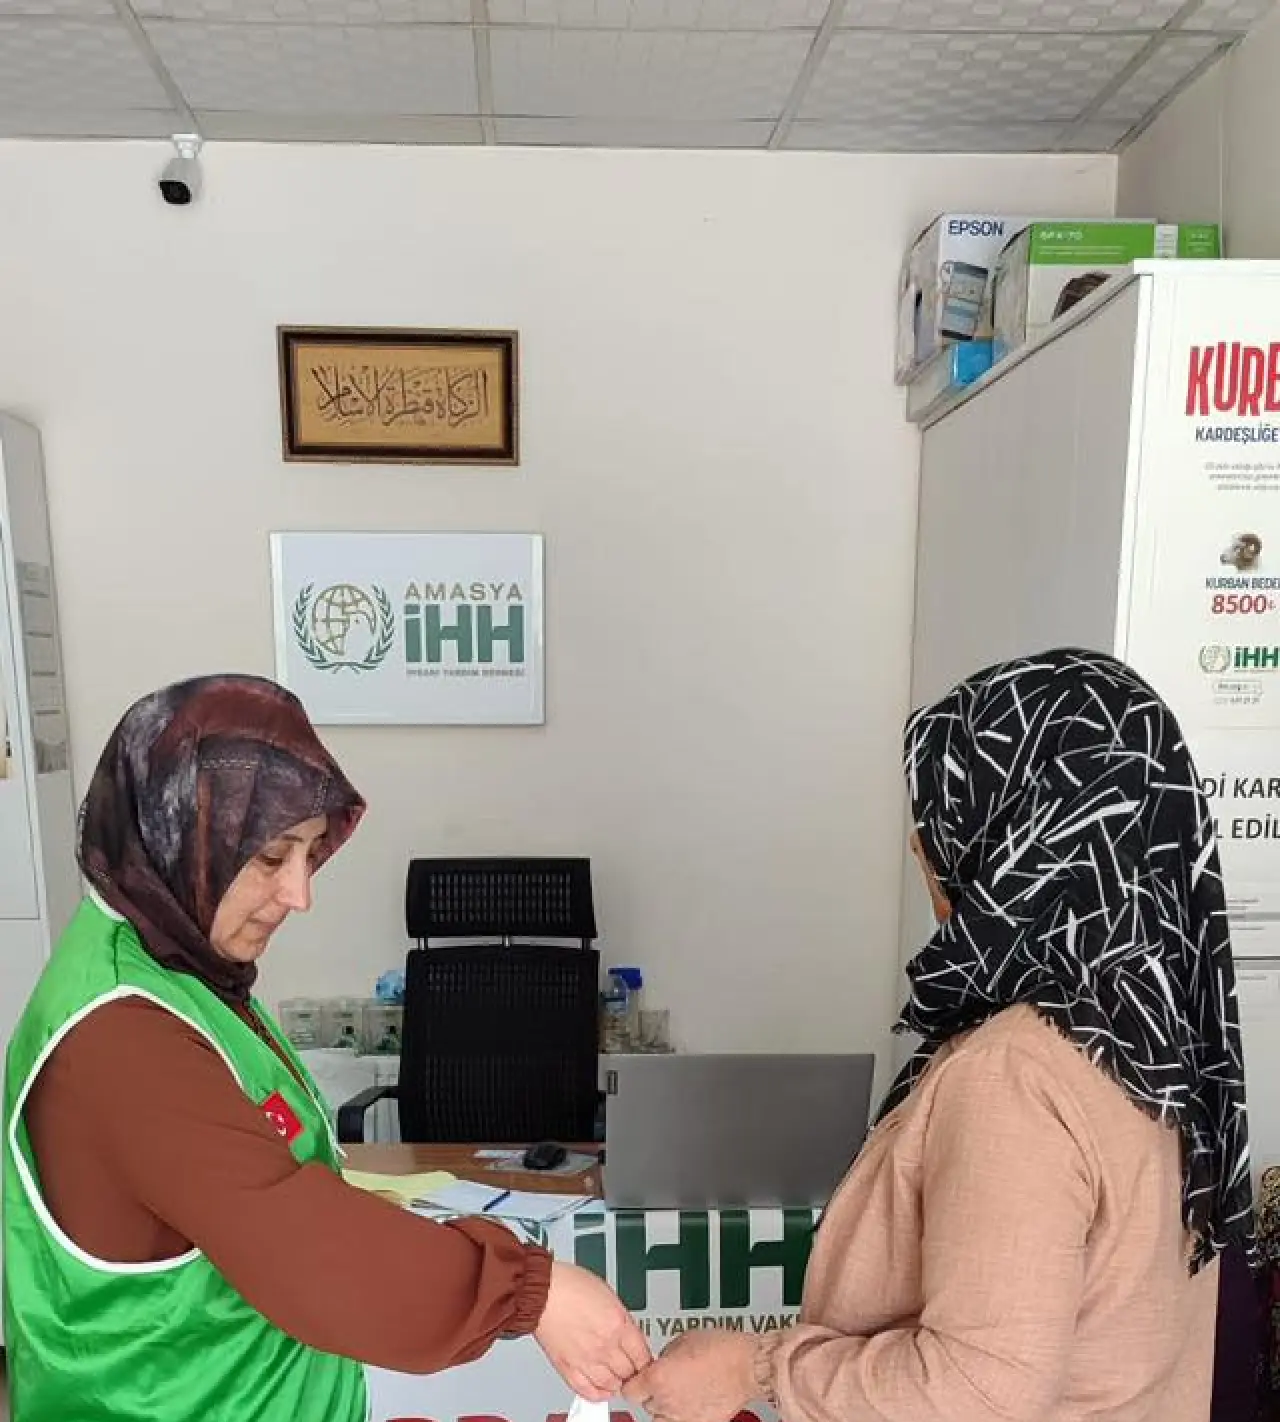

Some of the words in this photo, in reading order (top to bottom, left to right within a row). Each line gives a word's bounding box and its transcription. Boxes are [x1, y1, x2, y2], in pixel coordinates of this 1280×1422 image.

[947, 219, 1005, 238] EPSON
[404, 581, 523, 601] AMASYA
[1205, 577, 1249, 589] KURBAN
[750, 1313, 801, 1334] VAK
